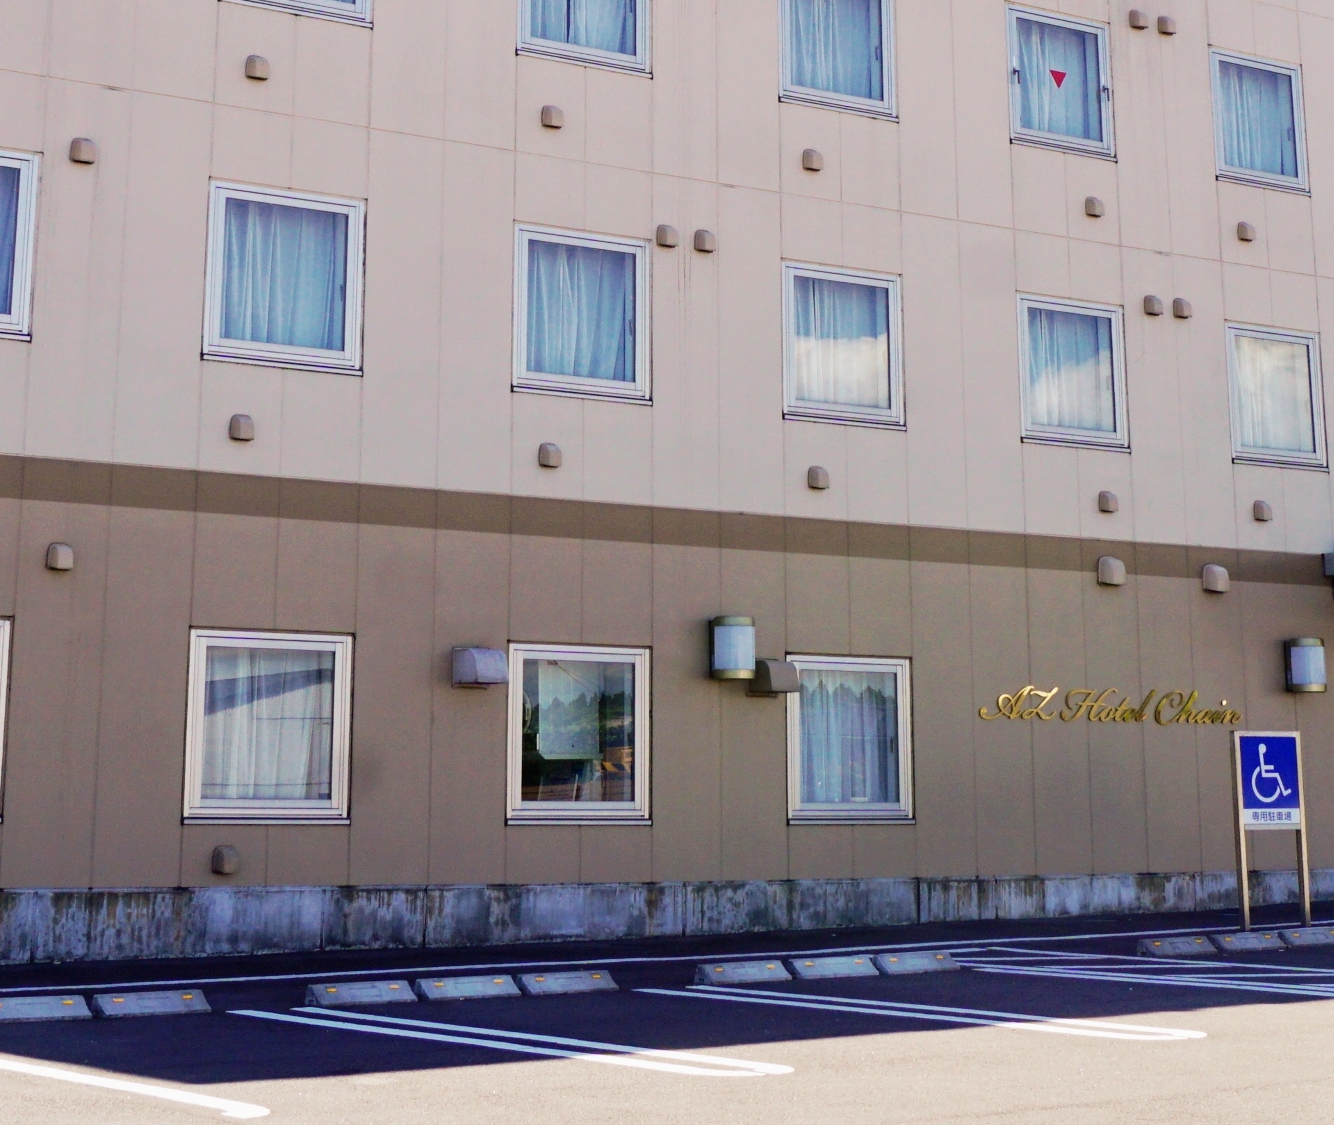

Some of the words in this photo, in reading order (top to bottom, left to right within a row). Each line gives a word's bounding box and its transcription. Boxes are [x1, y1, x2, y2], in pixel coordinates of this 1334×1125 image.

[979, 685, 1059, 721] AZ
[1060, 688, 1156, 723] Hotel
[1154, 690, 1243, 725] Chain
